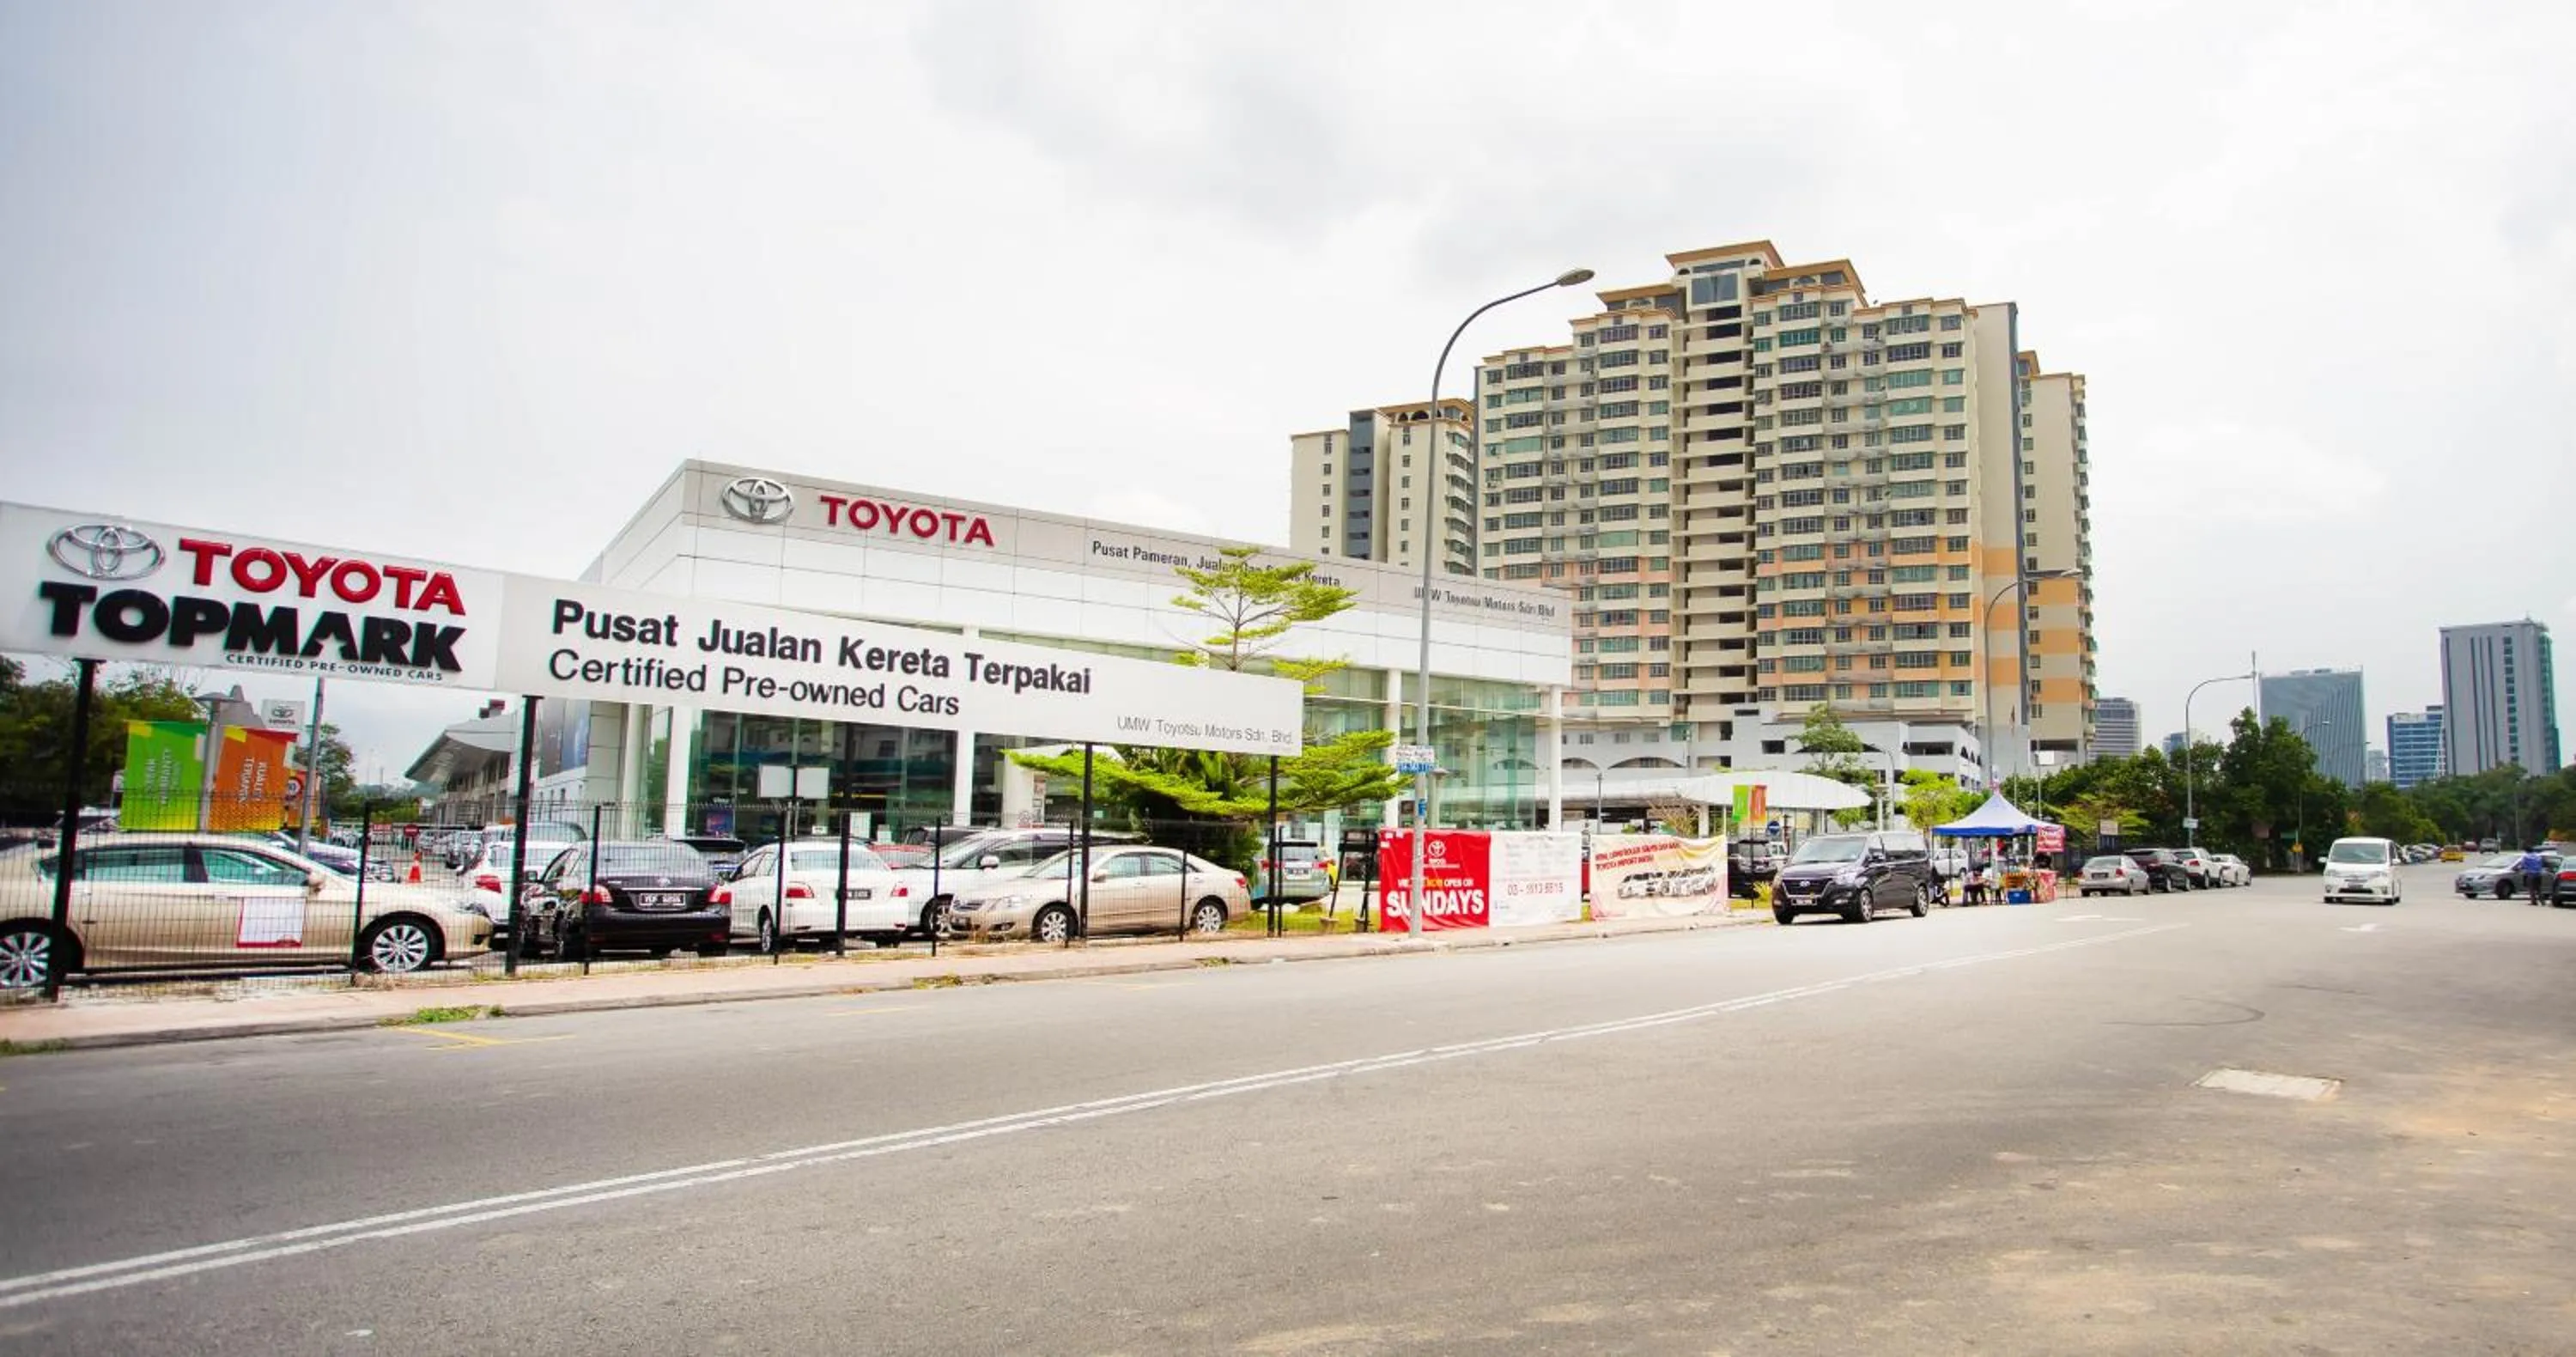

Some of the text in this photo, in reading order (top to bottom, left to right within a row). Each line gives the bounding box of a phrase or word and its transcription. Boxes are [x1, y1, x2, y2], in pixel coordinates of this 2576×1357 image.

[820, 495, 994, 547] TOYOTA
[178, 537, 466, 616] TOYOTA
[1092, 540, 1128, 558] Pusat
[1133, 546, 1191, 568] Pameran,
[1414, 587, 1442, 601] UW
[39, 581, 467, 672] TOPMARK
[551, 599, 1091, 694] Pusat Jualan Kereta Terpakai
[226, 654, 444, 681] CERTIFIED PRE-OWNED CARS
[549, 648, 961, 716] Certified Pre-owned Cars
[1116, 715, 1151, 733] UMW
[1156, 719, 1201, 738] Toyotsu
[1205, 724, 1242, 740] Motors
